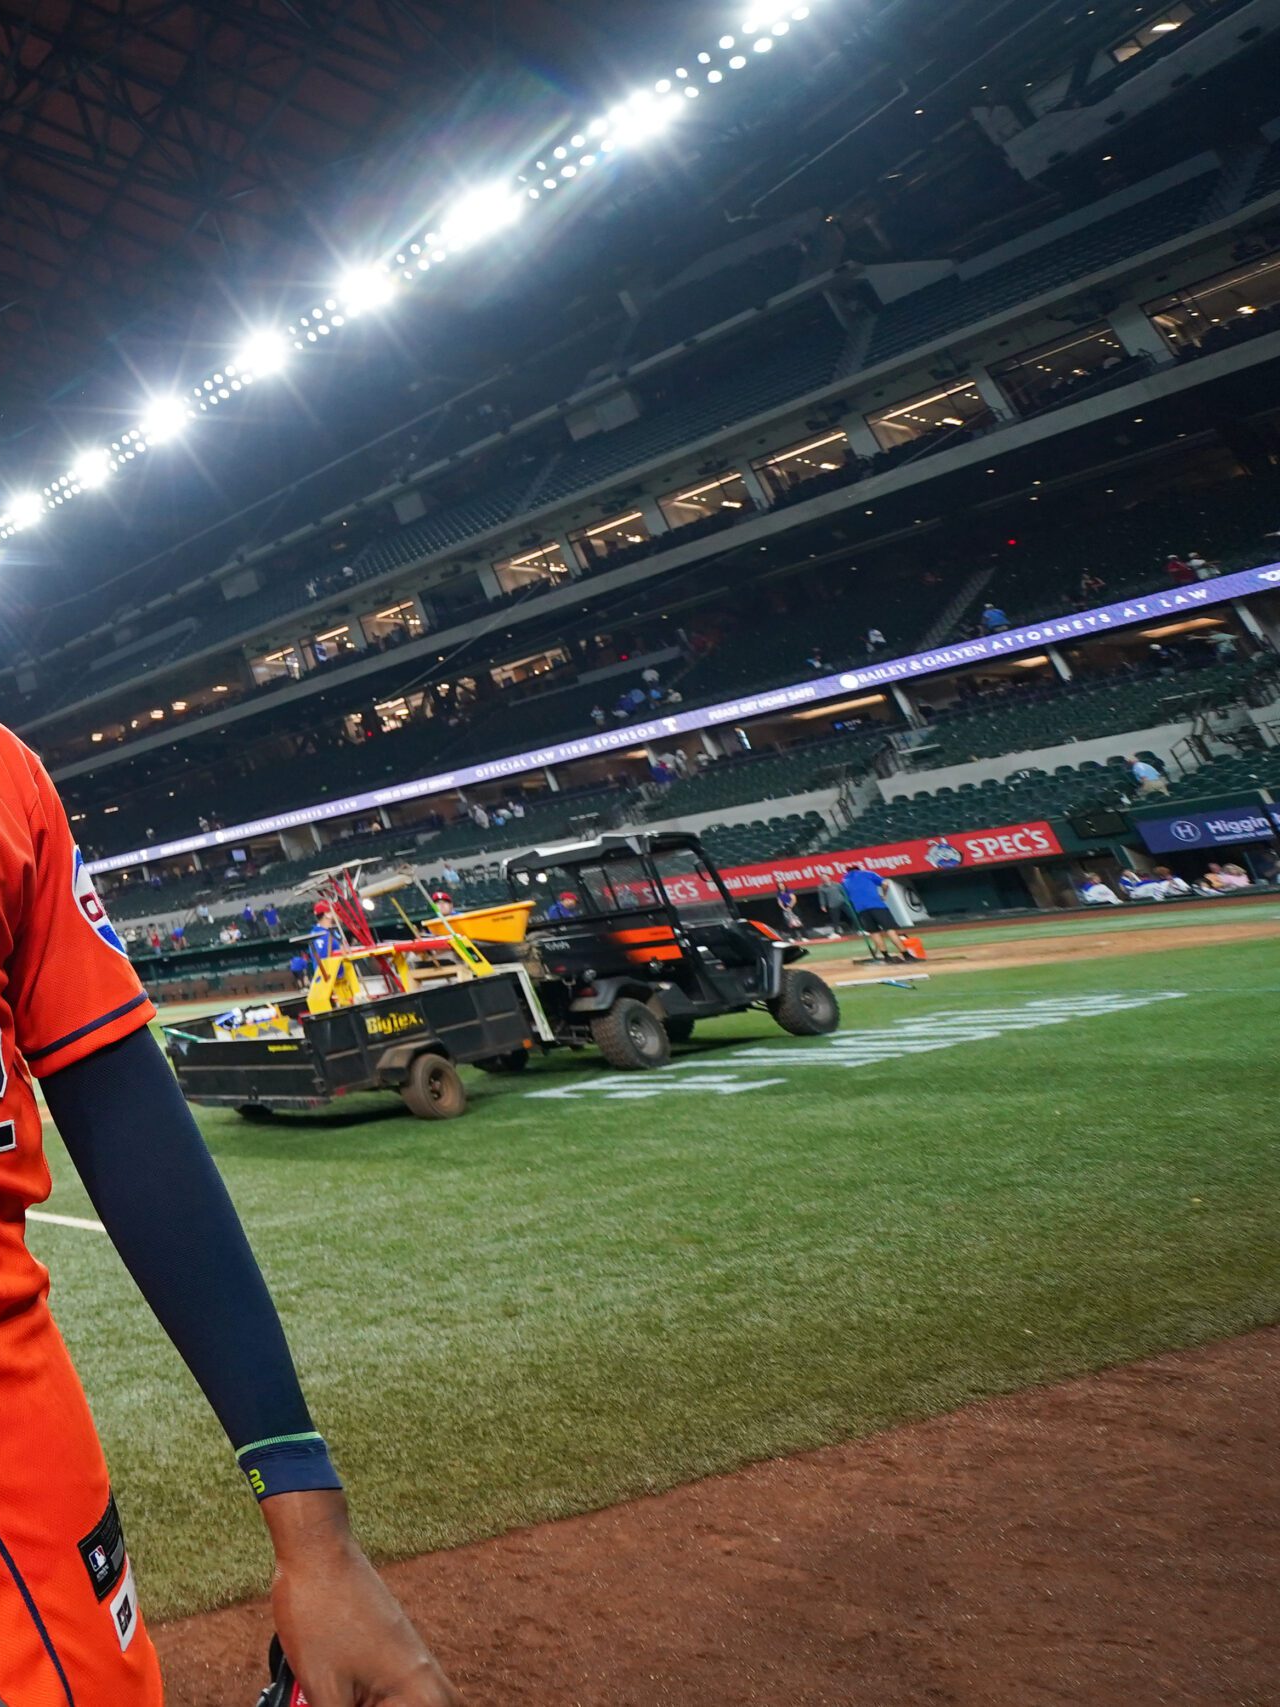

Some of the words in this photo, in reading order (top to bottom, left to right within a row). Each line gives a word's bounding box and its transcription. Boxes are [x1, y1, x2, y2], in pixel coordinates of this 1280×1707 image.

[858, 663, 907, 684] BAILEY
[908, 657, 922, 672] &
[922, 644, 987, 668] GALYEN
[991, 613, 1111, 650] ATTORNEYS
[1123, 603, 1149, 618] AT
[1160, 588, 1209, 610] LAW
[476, 758, 527, 778] OFFICIAL
[531, 751, 556, 766] LAW
[560, 743, 589, 757] FIRM
[595, 725, 657, 750] SPONSOR
[965, 827, 1050, 860] SPEC'S
[1205, 816, 1271, 834] Higgin
[642, 879, 698, 902] SEC'S
[772, 869, 801, 884] Store
[802, 865, 816, 879] of
[865, 853, 911, 871] Rangers
